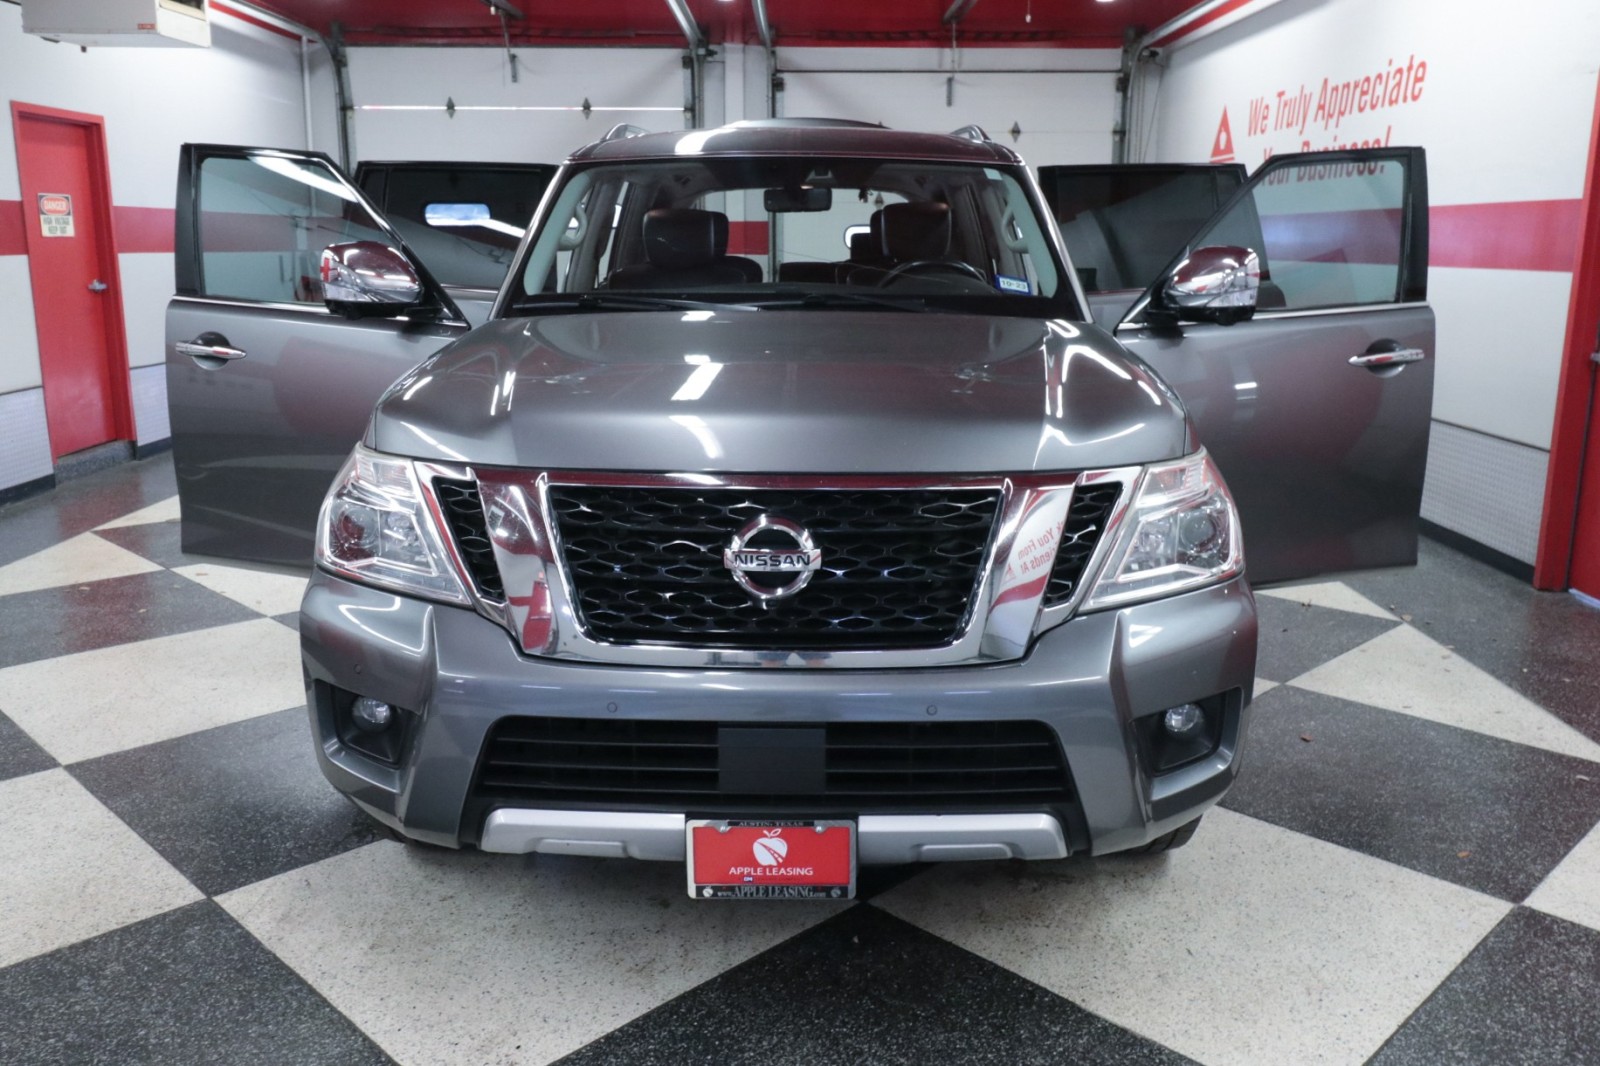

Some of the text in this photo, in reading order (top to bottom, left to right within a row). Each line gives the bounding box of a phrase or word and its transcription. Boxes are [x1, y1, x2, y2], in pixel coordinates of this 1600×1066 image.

[1247, 54, 1427, 138] We Truly Appreciate
[734, 554, 811, 567] NISSAN
[729, 866, 814, 876] APPLE LEASING
